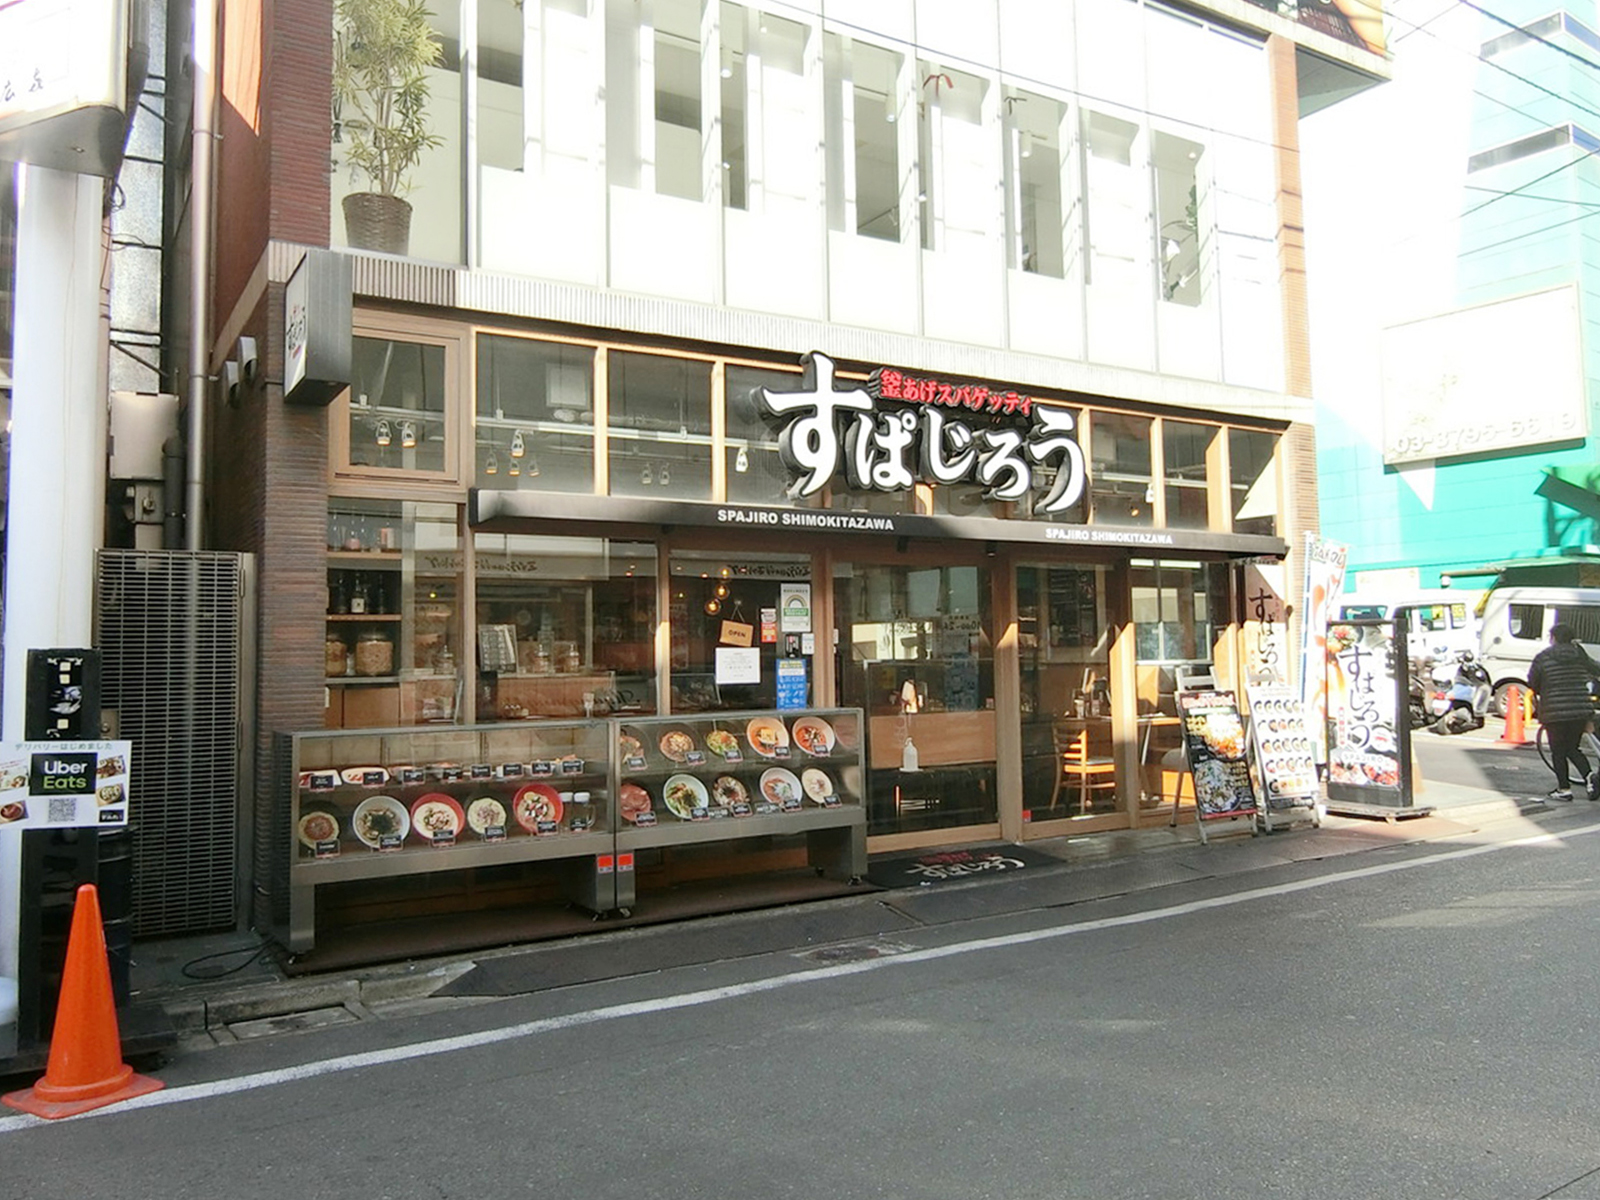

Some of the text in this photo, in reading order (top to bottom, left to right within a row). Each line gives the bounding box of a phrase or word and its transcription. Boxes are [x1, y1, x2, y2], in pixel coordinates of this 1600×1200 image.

[880, 368, 1032, 416] 釜あげスパゲッティ
[761, 351, 1085, 513] すぱじろう
[717, 509, 895, 531] SPAJIRO SHIMOKITAZAWA
[1045, 528, 1174, 545] SPAJIRO SHIMOKITAZAWA
[727, 628, 747, 638] OPEN
[15, 742, 113, 751] デリバリーはじめました
[44, 759, 88, 775] Uber
[43, 775, 87, 789] Eats
